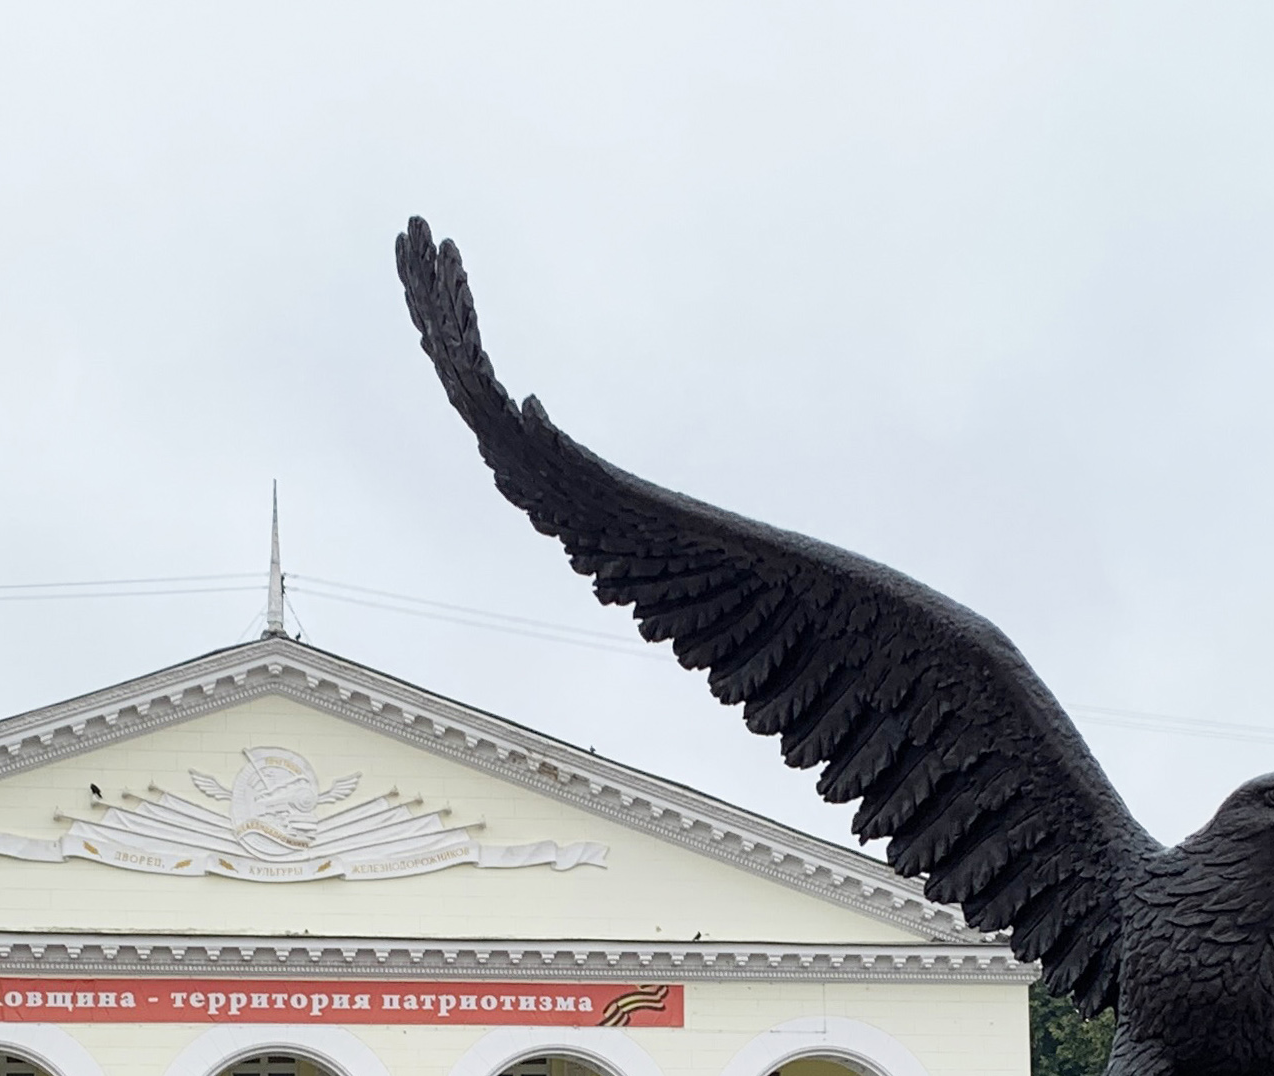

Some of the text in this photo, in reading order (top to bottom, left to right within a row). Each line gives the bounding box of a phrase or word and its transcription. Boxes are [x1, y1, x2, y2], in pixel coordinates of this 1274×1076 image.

[249, 865, 303, 876] КУЛЬТУРЫ
[351, 847, 470, 873] ЖЕЛЕЗНОДОРОЖНИКОВ
[171, 992, 371, 1016] территория
[381, 994, 594, 1017] патриотизма
